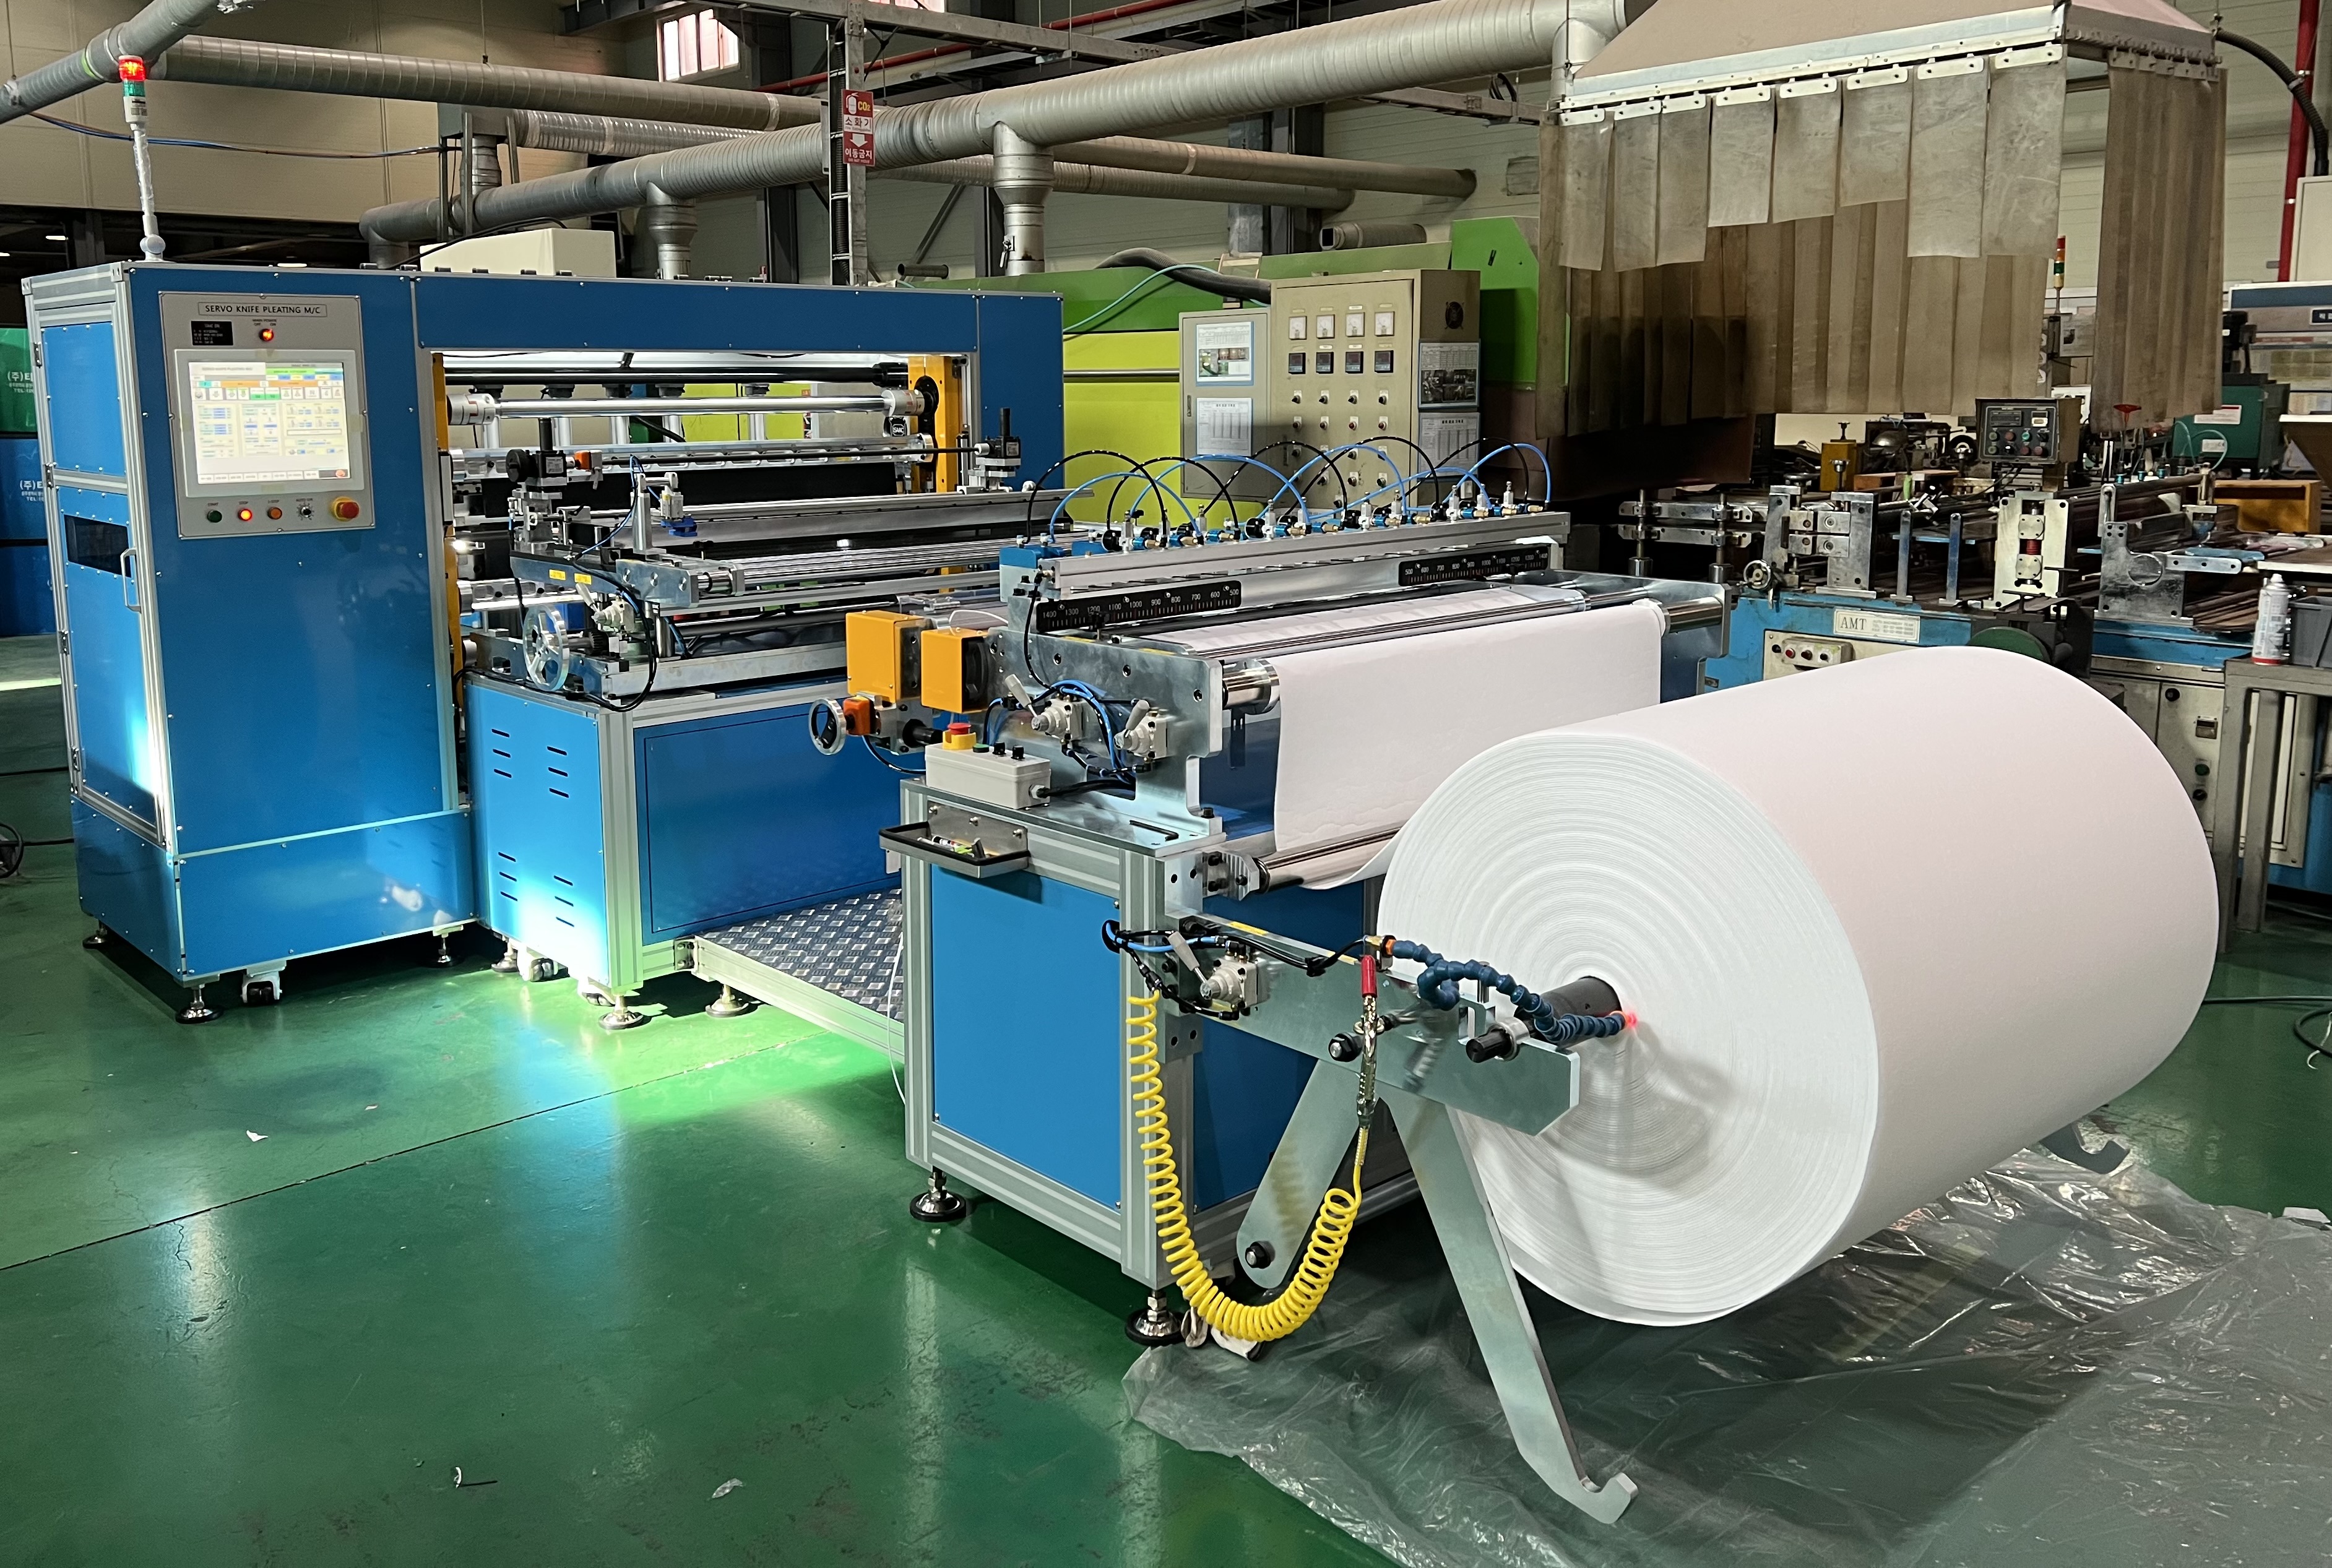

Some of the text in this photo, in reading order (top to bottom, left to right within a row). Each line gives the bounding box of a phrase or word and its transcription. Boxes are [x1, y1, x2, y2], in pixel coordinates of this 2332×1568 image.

[845, 116, 871, 129] 소화기
[845, 148, 872, 159] 이동금지
[1043, 610, 1057, 618] 1400
[1065, 608, 1079, 616] 1300
[1087, 605, 1100, 613] 1200
[1151, 598, 1161, 606] 900
[1840, 616, 1867, 630] AMT
